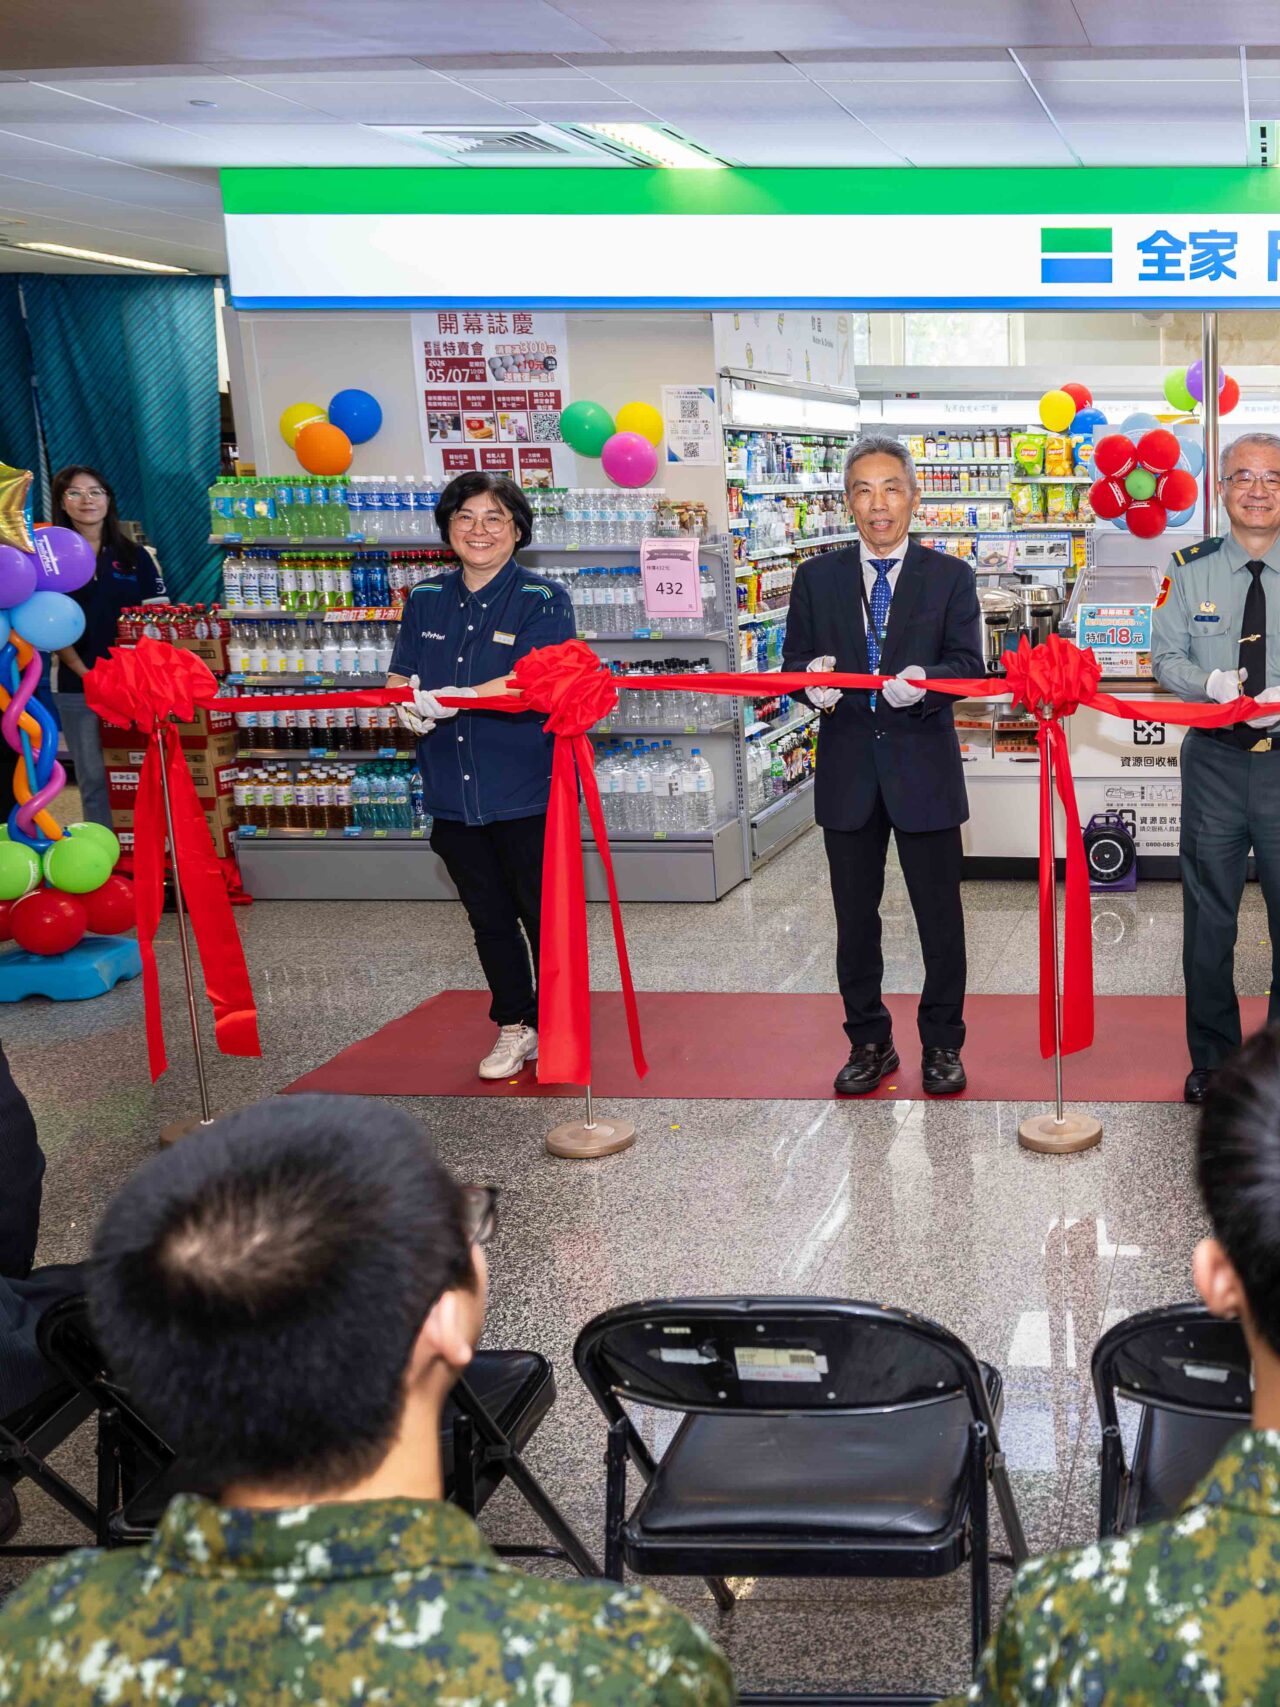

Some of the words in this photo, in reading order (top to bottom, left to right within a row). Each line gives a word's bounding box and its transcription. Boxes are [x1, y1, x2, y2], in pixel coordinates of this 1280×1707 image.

[1137, 229, 1238, 282] 全家
[437, 313, 534, 335] 開幕誌慶
[426, 368, 470, 383] 05/07
[655, 582, 683, 595] 432
[1085, 626, 1144, 645] 特價18元
[1120, 756, 1178, 767] 資源回收桶
